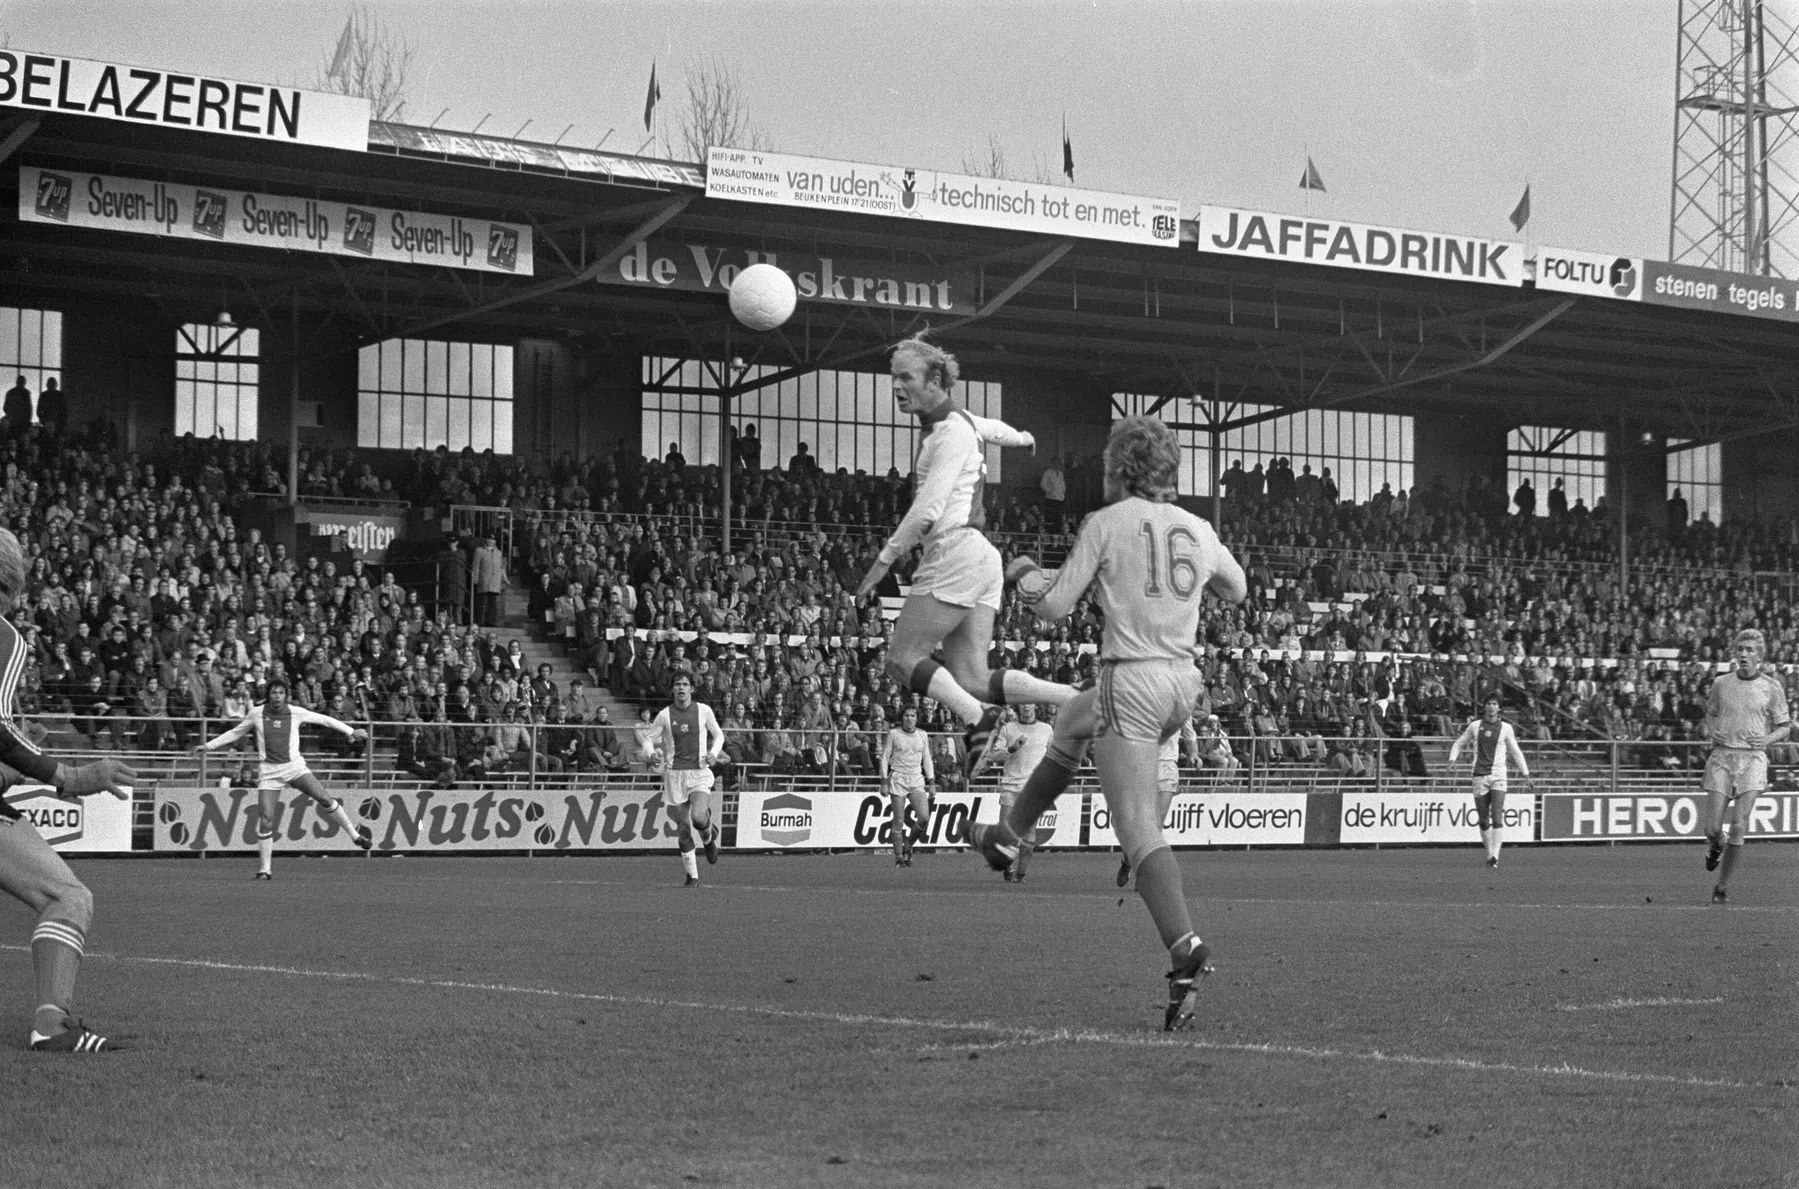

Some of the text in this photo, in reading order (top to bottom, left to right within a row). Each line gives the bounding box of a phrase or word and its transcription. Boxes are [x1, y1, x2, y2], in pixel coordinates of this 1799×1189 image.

[0, 51, 301, 139] BELAZEREN
[711, 167, 780, 183] WASAUTOMATEN
[752, 156, 764, 166] TV
[710, 183, 764, 196] KOELKASTEN
[787, 171, 823, 192] van
[795, 191, 849, 205] BEUKENPLEIN
[940, 182, 1146, 229] technisch tot en met.
[88, 175, 179, 233] Seven-Up
[242, 193, 330, 249] Seven-Up
[391, 211, 474, 265] Seven-Up
[1152, 214, 1177, 232] TELE
[1211, 212, 1510, 280] JAFFADRINK
[620, 240, 953, 311] de Voskrant
[1544, 258, 1605, 285] FOLTU
[1655, 274, 1718, 300] stenen
[1728, 283, 1785, 311] tegels
[1139, 518, 1200, 601] 16
[19, 808, 80, 828] XACO
[189, 789, 344, 850] Nuts
[378, 790, 524, 850] Nuts
[760, 812, 813, 828] Burmah
[854, 795, 983, 845] Castrol
[1037, 813, 1058, 827] trol
[1162, 803, 1205, 834] uijff
[1208, 806, 1303, 829] vloeren
[1344, 802, 1532, 834] de kruijff vloen
[1572, 797, 1698, 835] HERO
